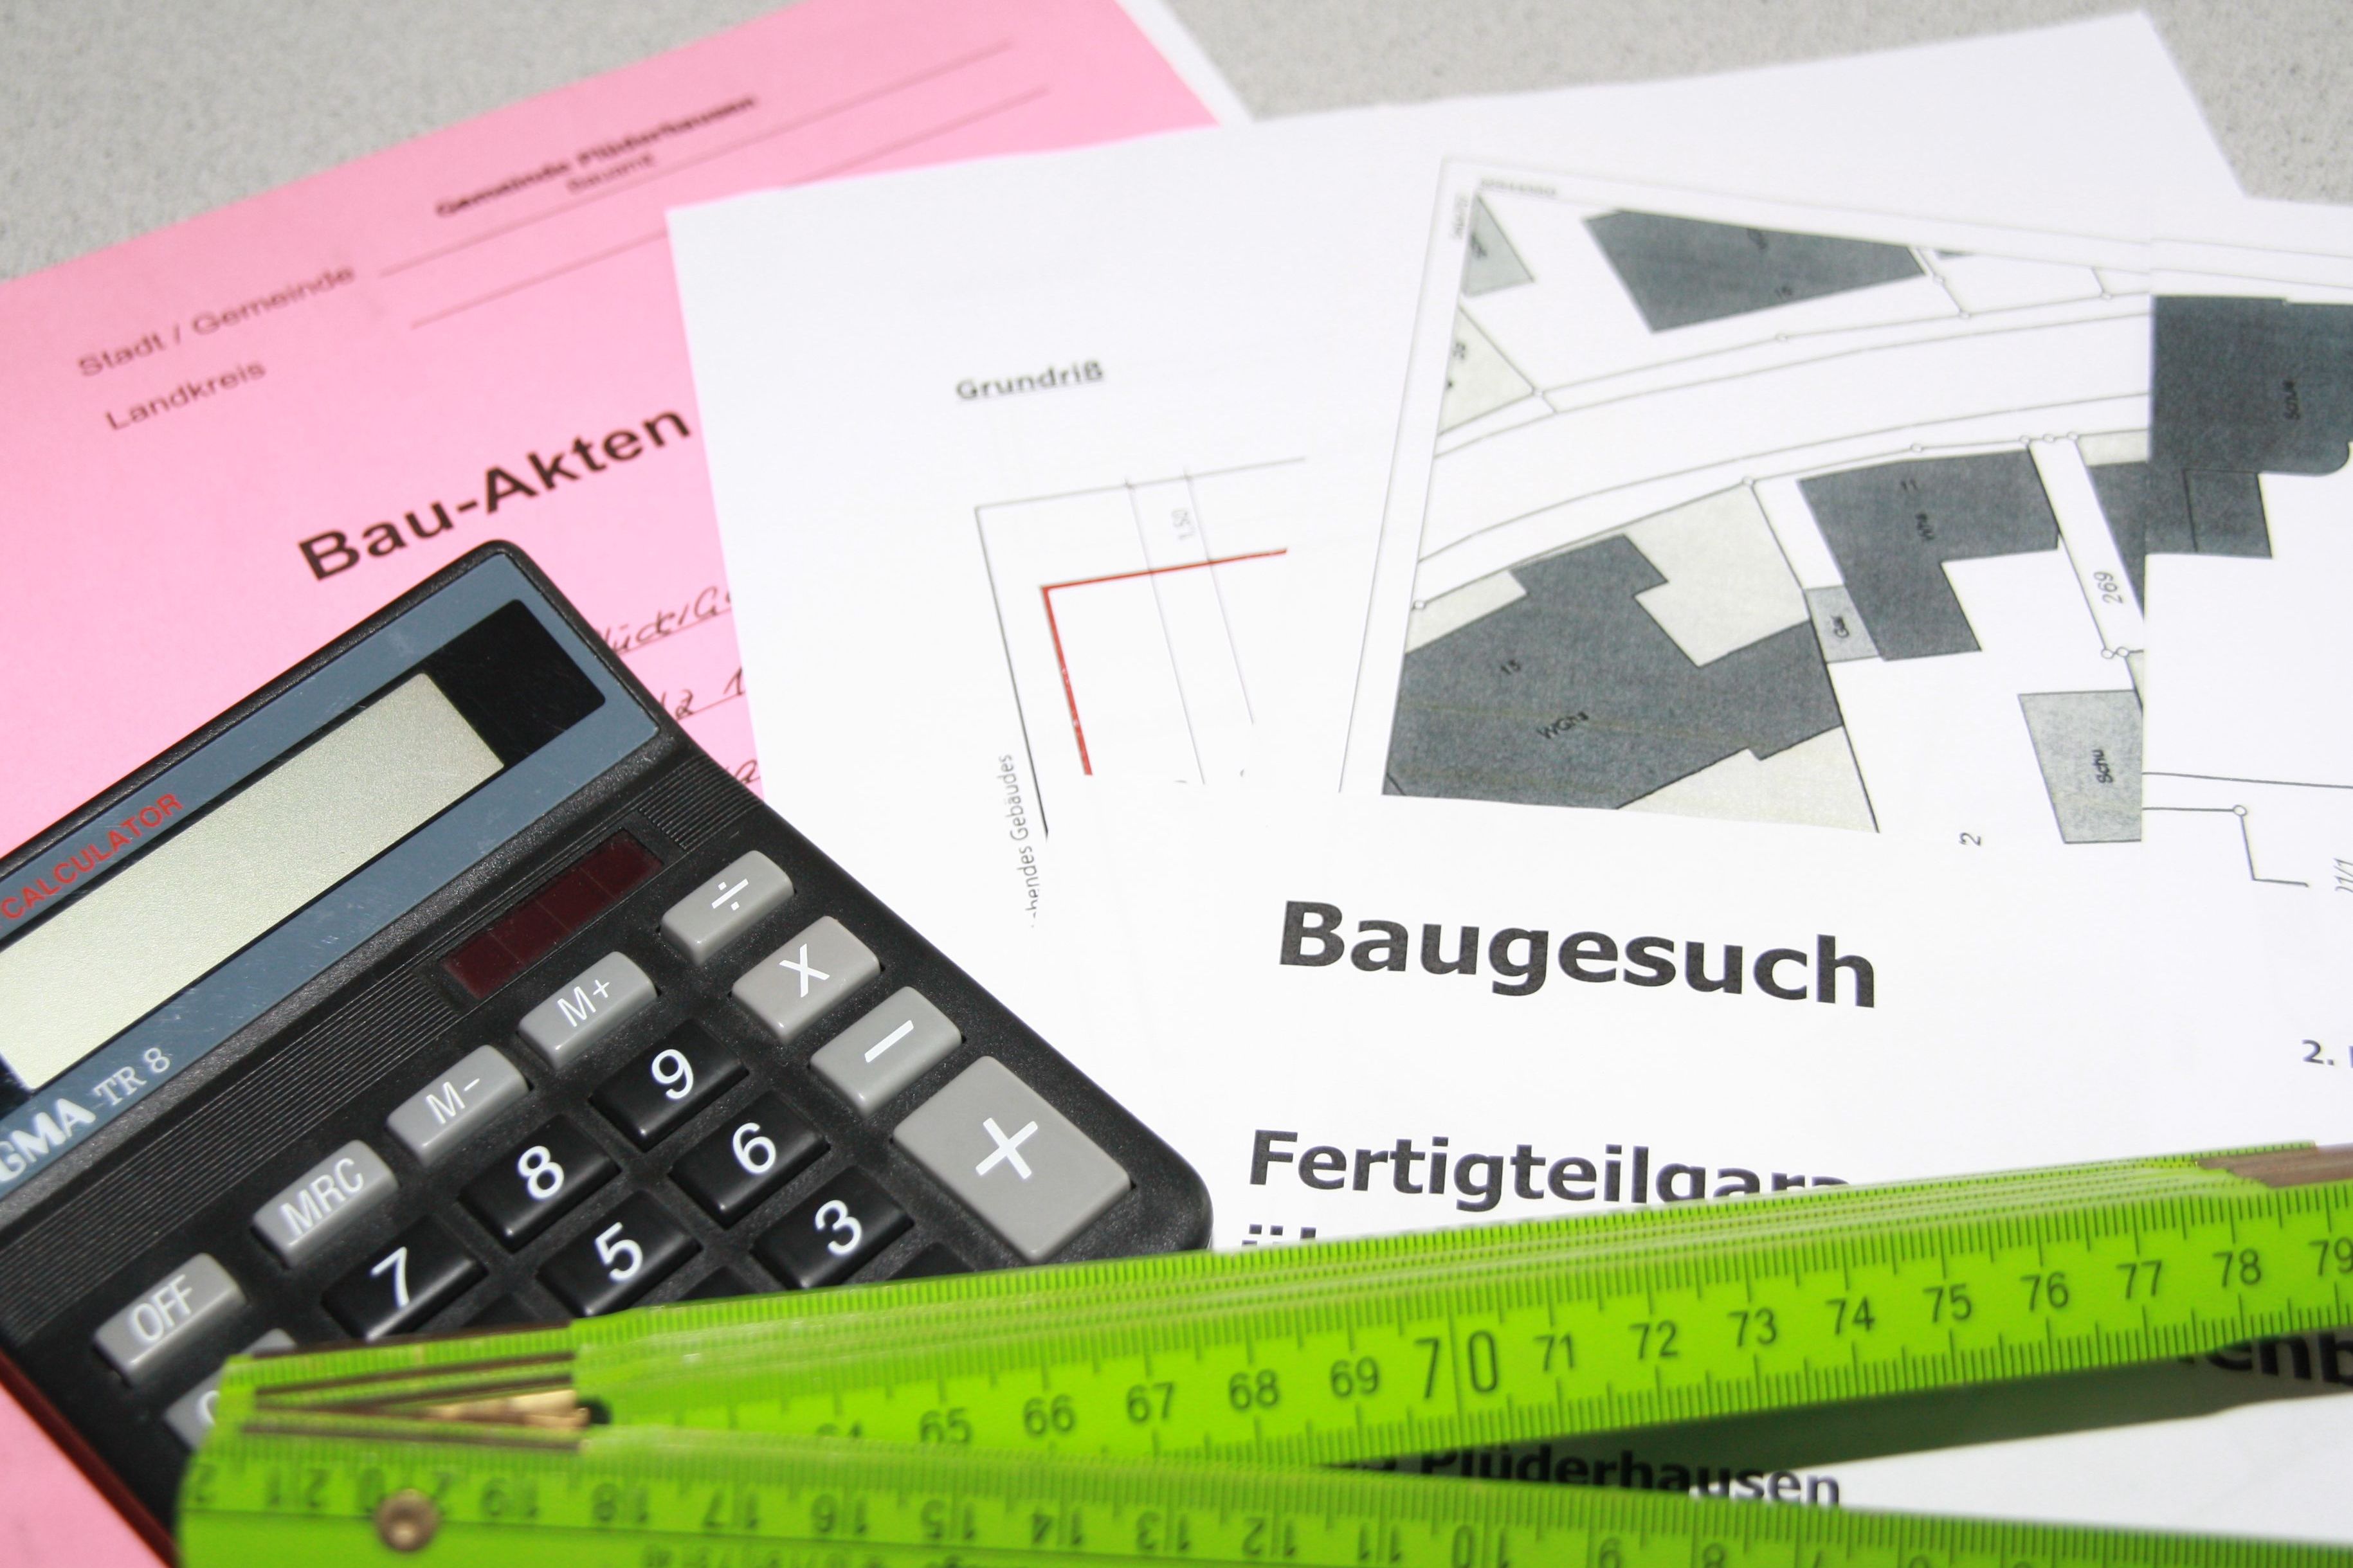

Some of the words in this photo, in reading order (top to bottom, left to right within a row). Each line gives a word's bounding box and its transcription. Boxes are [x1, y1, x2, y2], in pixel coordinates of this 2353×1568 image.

[78, 331, 167, 377] Stadt
[191, 265, 357, 336] Gemeinde
[105, 358, 267, 431] Landkreis
[956, 359, 1105, 402] Grundriß
[297, 410, 692, 581] Bau-Akten
[2093, 571, 2124, 604] 269
[998, 754, 1028, 842] Gebäudes
[1, 791, 184, 921] CALCULATOR
[1279, 900, 1875, 1008] Baugesuch
[556, 976, 611, 1027] M+
[93, 1065, 147, 1107] TR
[143, 1047, 172, 1074] 8
[651, 1048, 695, 1100] 9
[2301, 1038, 2335, 1067] 2.
[517, 1145, 565, 1200] 8
[732, 1121, 777, 1175] 6
[279, 1157, 365, 1236] MRC
[594, 1221, 644, 1282] 5
[814, 1199, 863, 1256] 3
[370, 1246, 410, 1308] 7
[132, 1274, 194, 1342] OFF
[1022, 1394, 1076, 1437] 66
[1126, 1382, 1176, 1425] 67
[1228, 1368, 1280, 1412] 68
[1330, 1356, 1381, 1399] 69
[1415, 1329, 1500, 1400] 70
[1534, 1332, 1576, 1374] 71
[1629, 1320, 1679, 1361] 72
[1727, 1307, 1779, 1349] 73
[1826, 1296, 1876, 1337] 74
[1923, 1283, 1972, 1324] 75
[2019, 1271, 2069, 1313] 76
[2116, 1259, 2165, 1301] 77
[2212, 1248, 2262, 1289] 78
[2309, 1236, 2353, 1278] 79
[479, 1479, 539, 1519] 19
[592, 1482, 650, 1524] 18
[704, 1487, 760, 1530] 17
[811, 1493, 869, 1537] 16
[920, 1499, 977, 1542] 15
[1031, 1503, 1087, 1546] 14
[1136, 1508, 1192, 1553] 13
[1242, 1515, 1298, 1560] 12
[1358, 1522, 1403, 1563] 11
